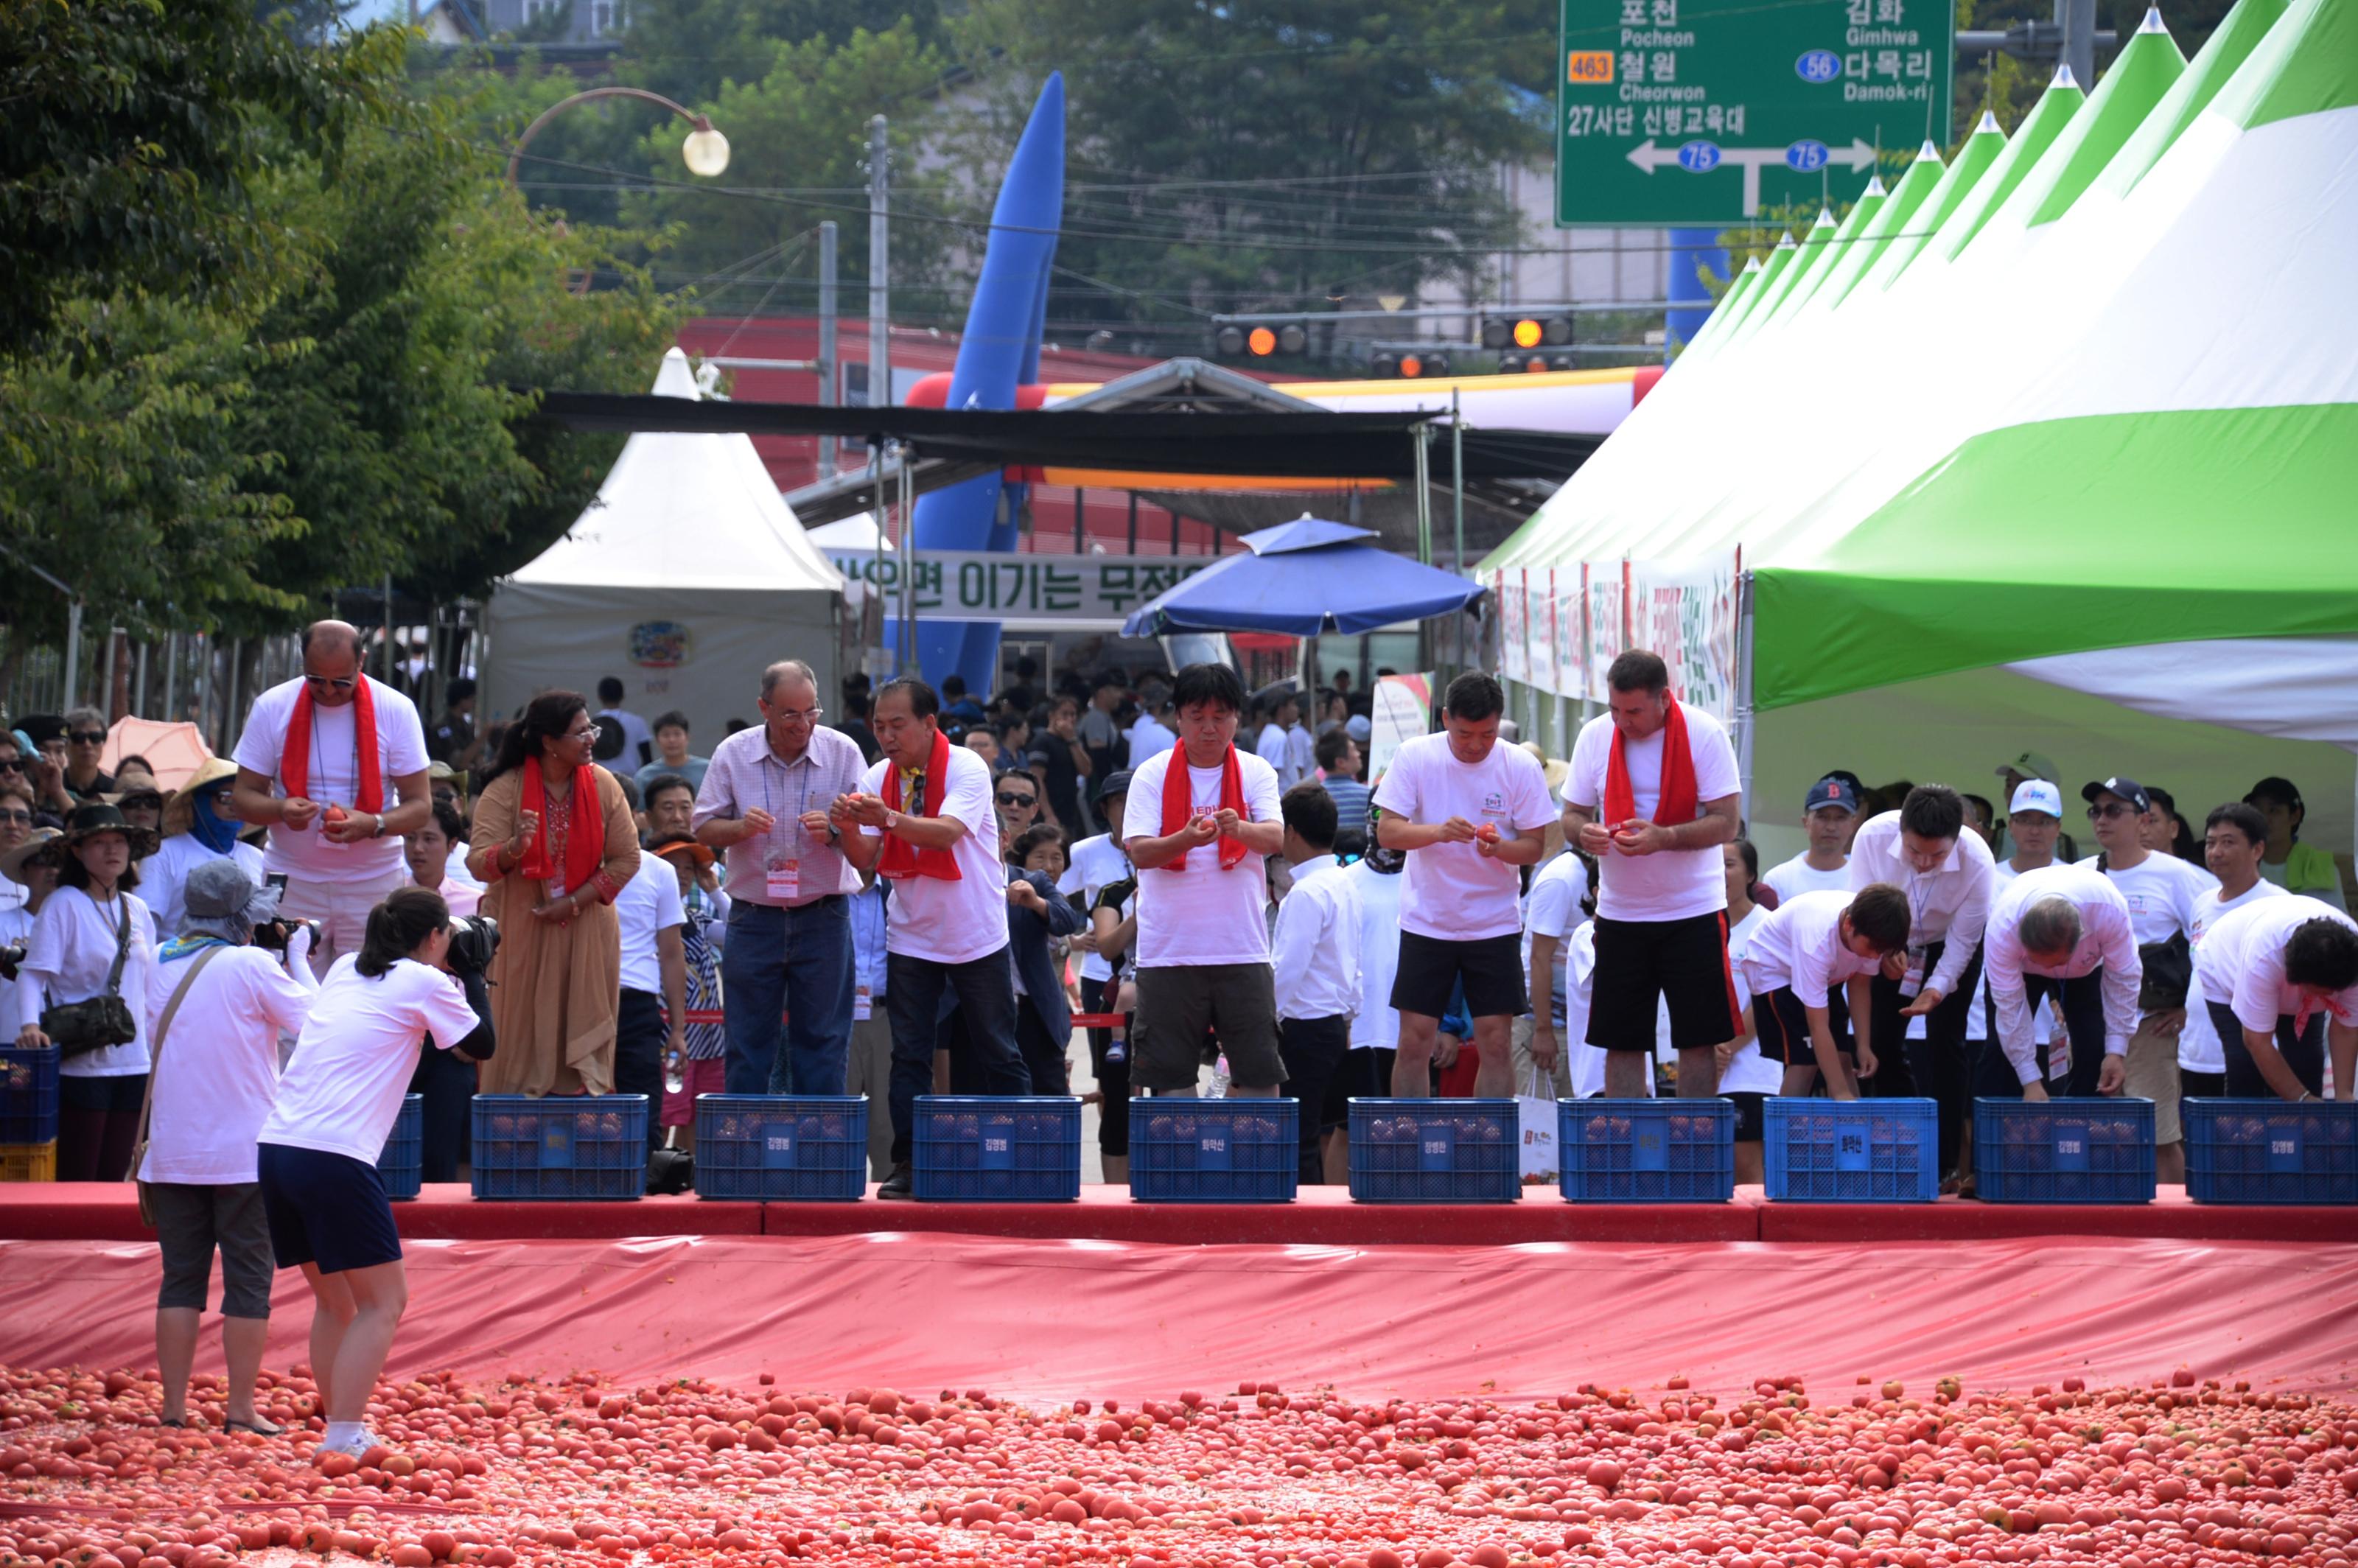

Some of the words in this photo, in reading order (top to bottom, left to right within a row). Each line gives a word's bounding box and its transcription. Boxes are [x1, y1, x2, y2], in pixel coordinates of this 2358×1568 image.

[1620, 0, 1678, 27] 포천
[1845, 0, 1906, 24] 김화
[1621, 29, 1695, 47] Pocheon
[1846, 28, 1919, 46] Gimhwa
[1574, 57, 1609, 77] 463
[1619, 51, 1676, 82] 철원
[1808, 55, 1832, 77] 56
[1844, 49, 1933, 81] 다목리
[1619, 83, 1706, 102] Cheorwon
[1844, 82, 1927, 102] Damok-ri
[1567, 105, 1634, 136] 27사단
[1642, 104, 1746, 136] 신병교육대
[1687, 144, 1712, 169] 75
[1795, 144, 1820, 167] 75
[959, 561, 1082, 610] 이기는
[1829, 783, 1840, 799] B
